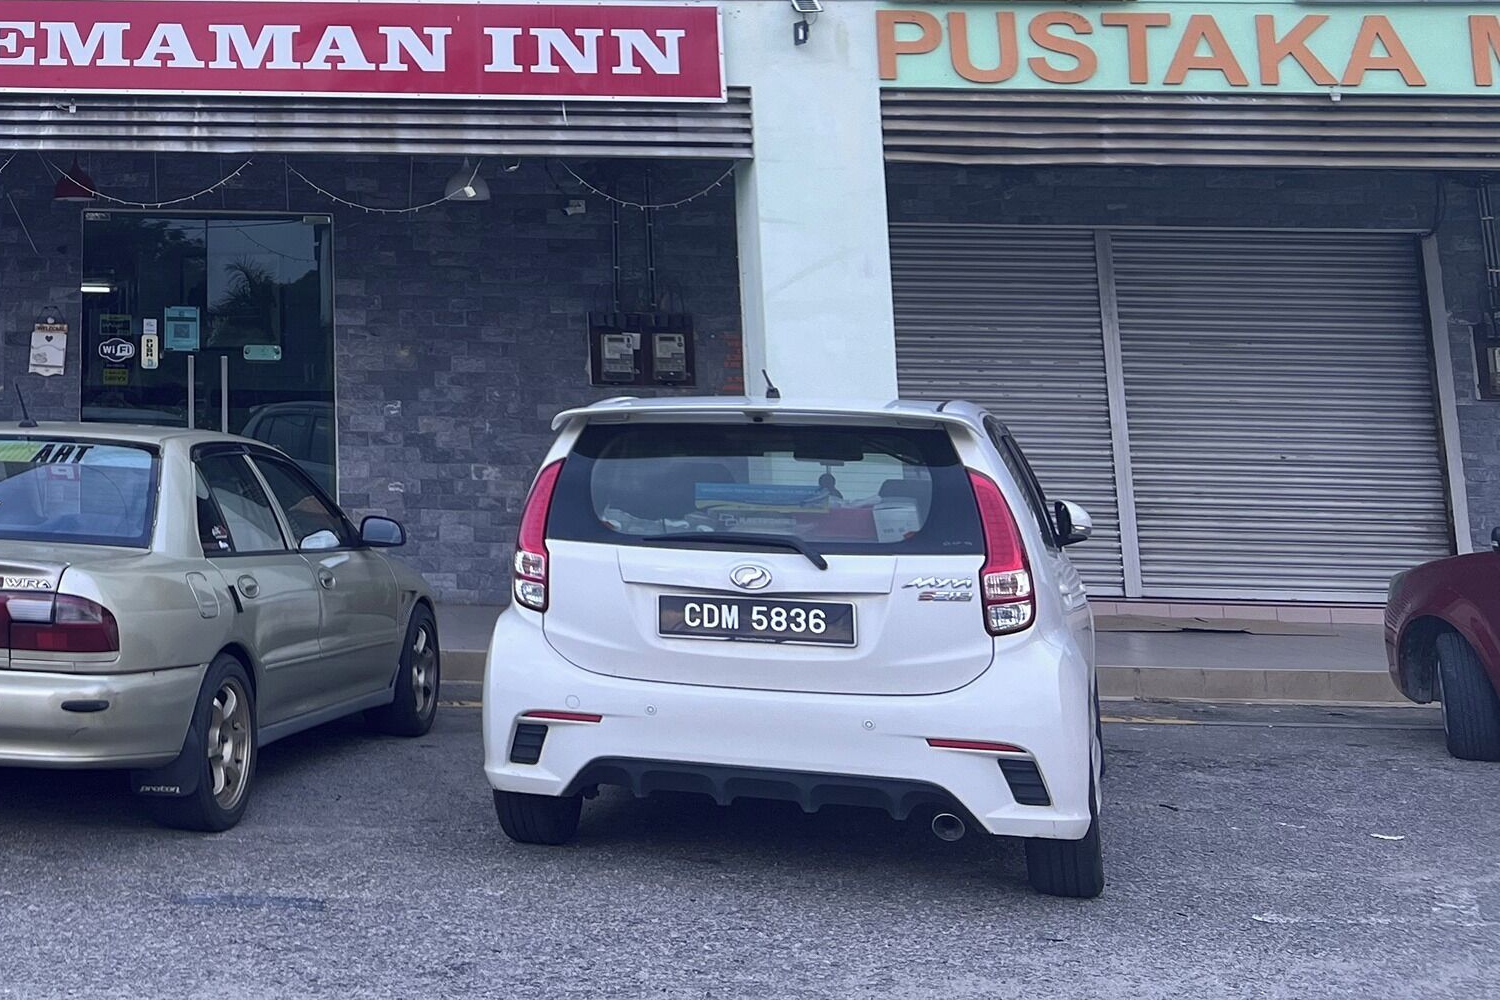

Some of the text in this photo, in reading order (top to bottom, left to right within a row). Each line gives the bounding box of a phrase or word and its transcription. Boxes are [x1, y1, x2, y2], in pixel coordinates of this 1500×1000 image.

[483, 26, 685, 76] INN
[875, 9, 1427, 87] PUSTAKA
[30, 444, 95, 465] ART
[5, 578, 52, 589] WIRA
[684, 603, 827, 634] CDM 5836
[139, 785, 181, 794] proton
